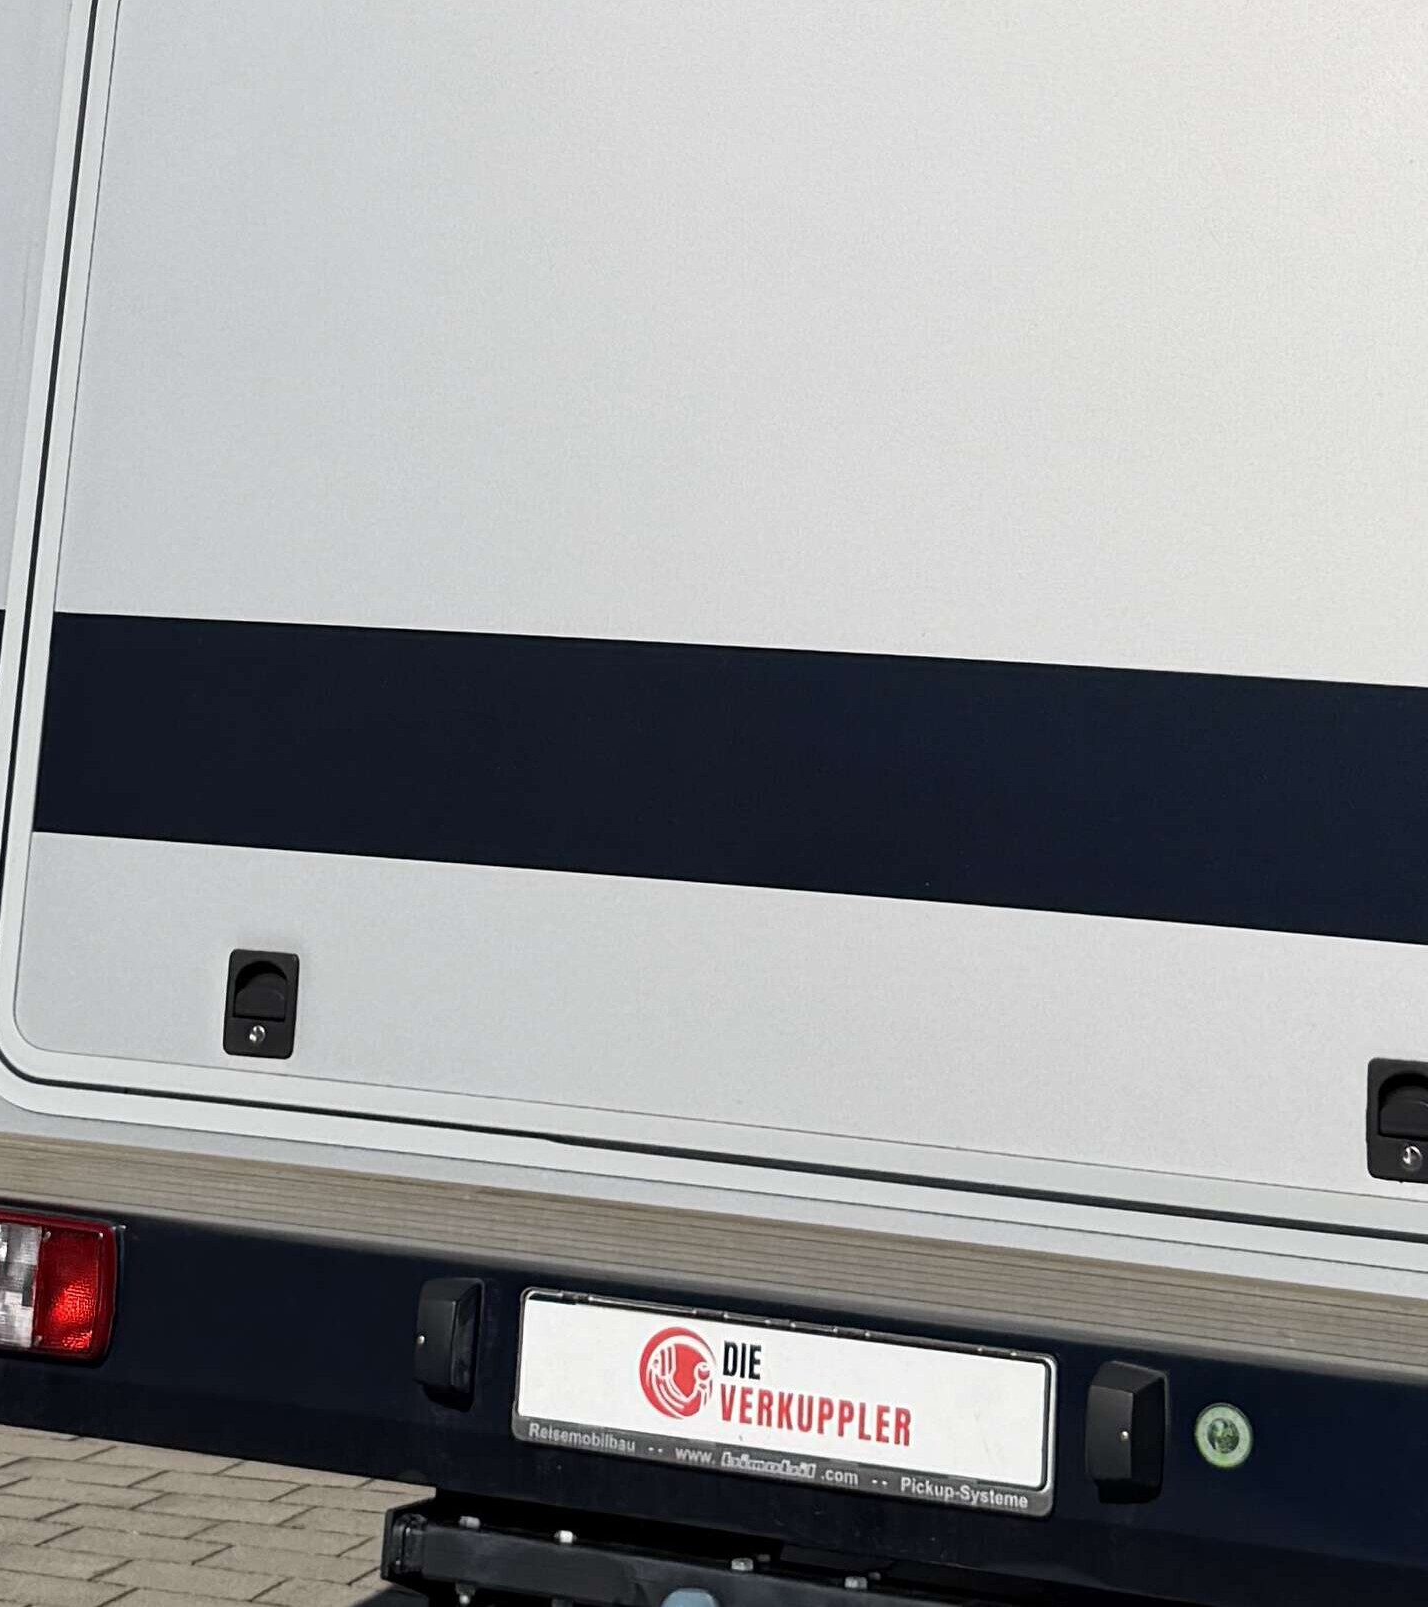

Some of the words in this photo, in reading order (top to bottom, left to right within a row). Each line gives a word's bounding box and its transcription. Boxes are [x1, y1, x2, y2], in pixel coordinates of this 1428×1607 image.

[722, 1340, 762, 1381] DIE
[720, 1383, 912, 1447] VERKUPPLER
[528, 1422, 636, 1454] Reisemobilbau
[900, 1476, 1029, 1509] Pickup-Systeme
